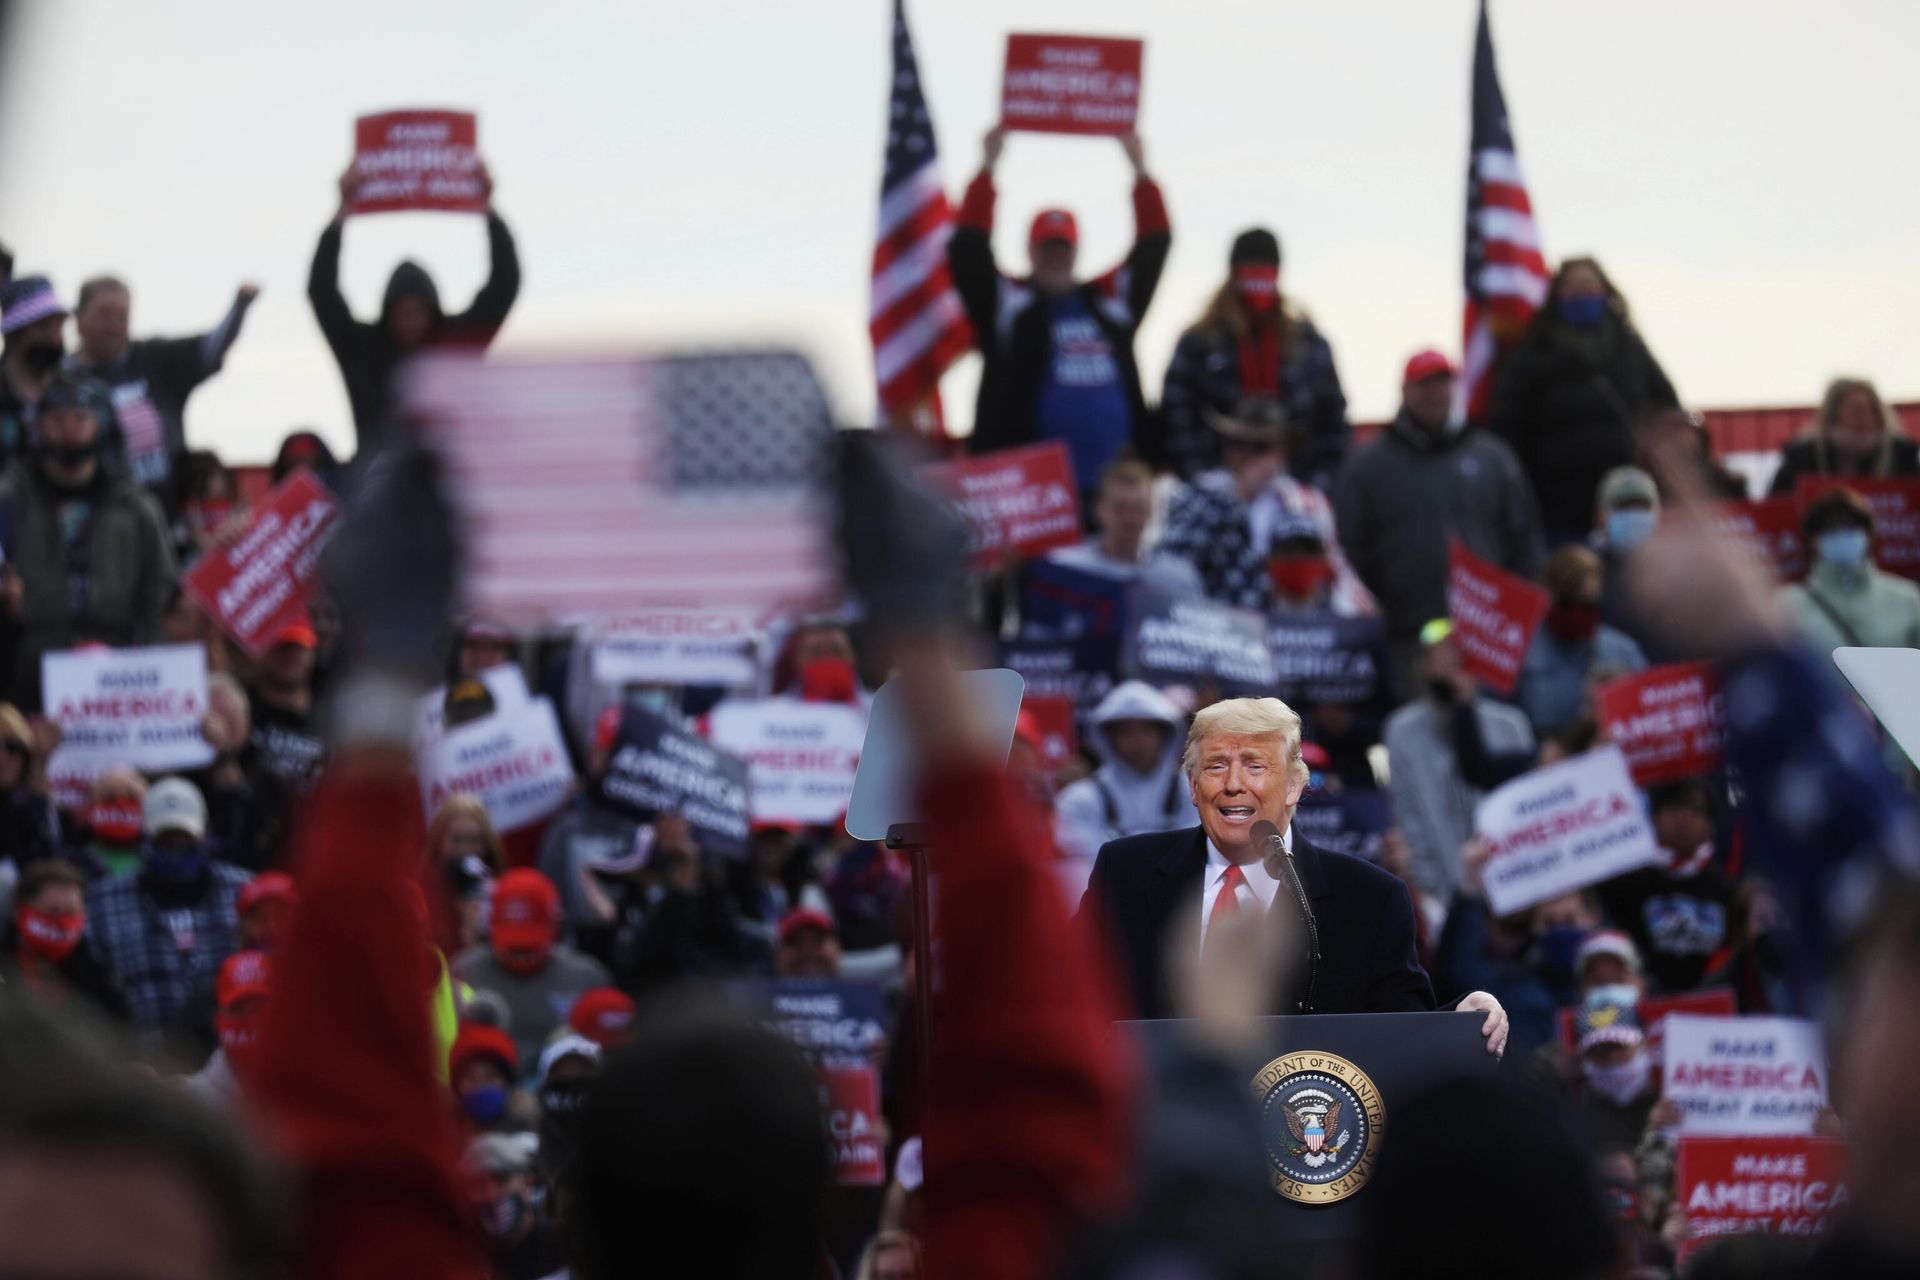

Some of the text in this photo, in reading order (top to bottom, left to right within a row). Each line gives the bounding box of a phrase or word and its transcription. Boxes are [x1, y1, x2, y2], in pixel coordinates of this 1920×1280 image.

[60, 690, 199, 722] AMERICA
[1483, 792, 1631, 864] AMERICA
[1673, 1061, 1822, 1093] AMERICA
[1253, 1056, 1385, 1197] SIDENT OF THE UNITED STATES
[1732, 1154, 1807, 1177] MAKE
[1273, 1172, 1304, 1197] SEA
[1687, 1180, 1850, 1215] AMERICA
[1687, 1215, 1773, 1239] GREAT
